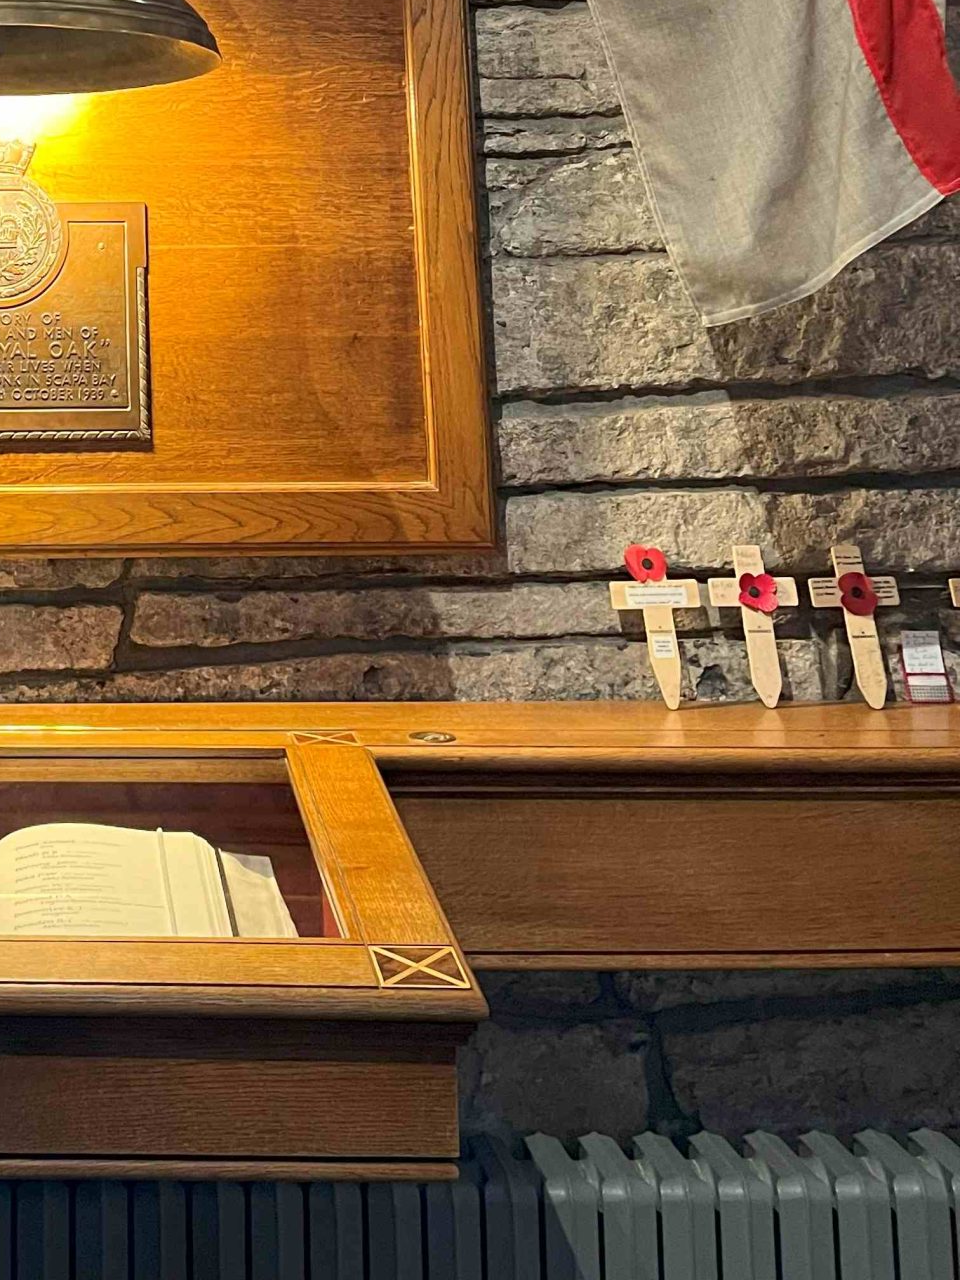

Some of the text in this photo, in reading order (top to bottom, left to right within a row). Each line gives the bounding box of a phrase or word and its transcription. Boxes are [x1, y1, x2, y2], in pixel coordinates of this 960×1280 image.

[41, 312, 61, 326] OF
[5, 327, 37, 341] AND
[43, 326, 74, 341] MEN
[80, 326, 99, 340] OF
[20, 359, 56, 374] LIVES
[63, 360, 103, 374] WHEN
[27, 375, 41, 388] IN
[45, 374, 89, 388] SCAPA
[92, 373, 117, 388] BAY
[11, 387, 74, 401] OCTOBER
[77, 386, 106, 401] 1939
